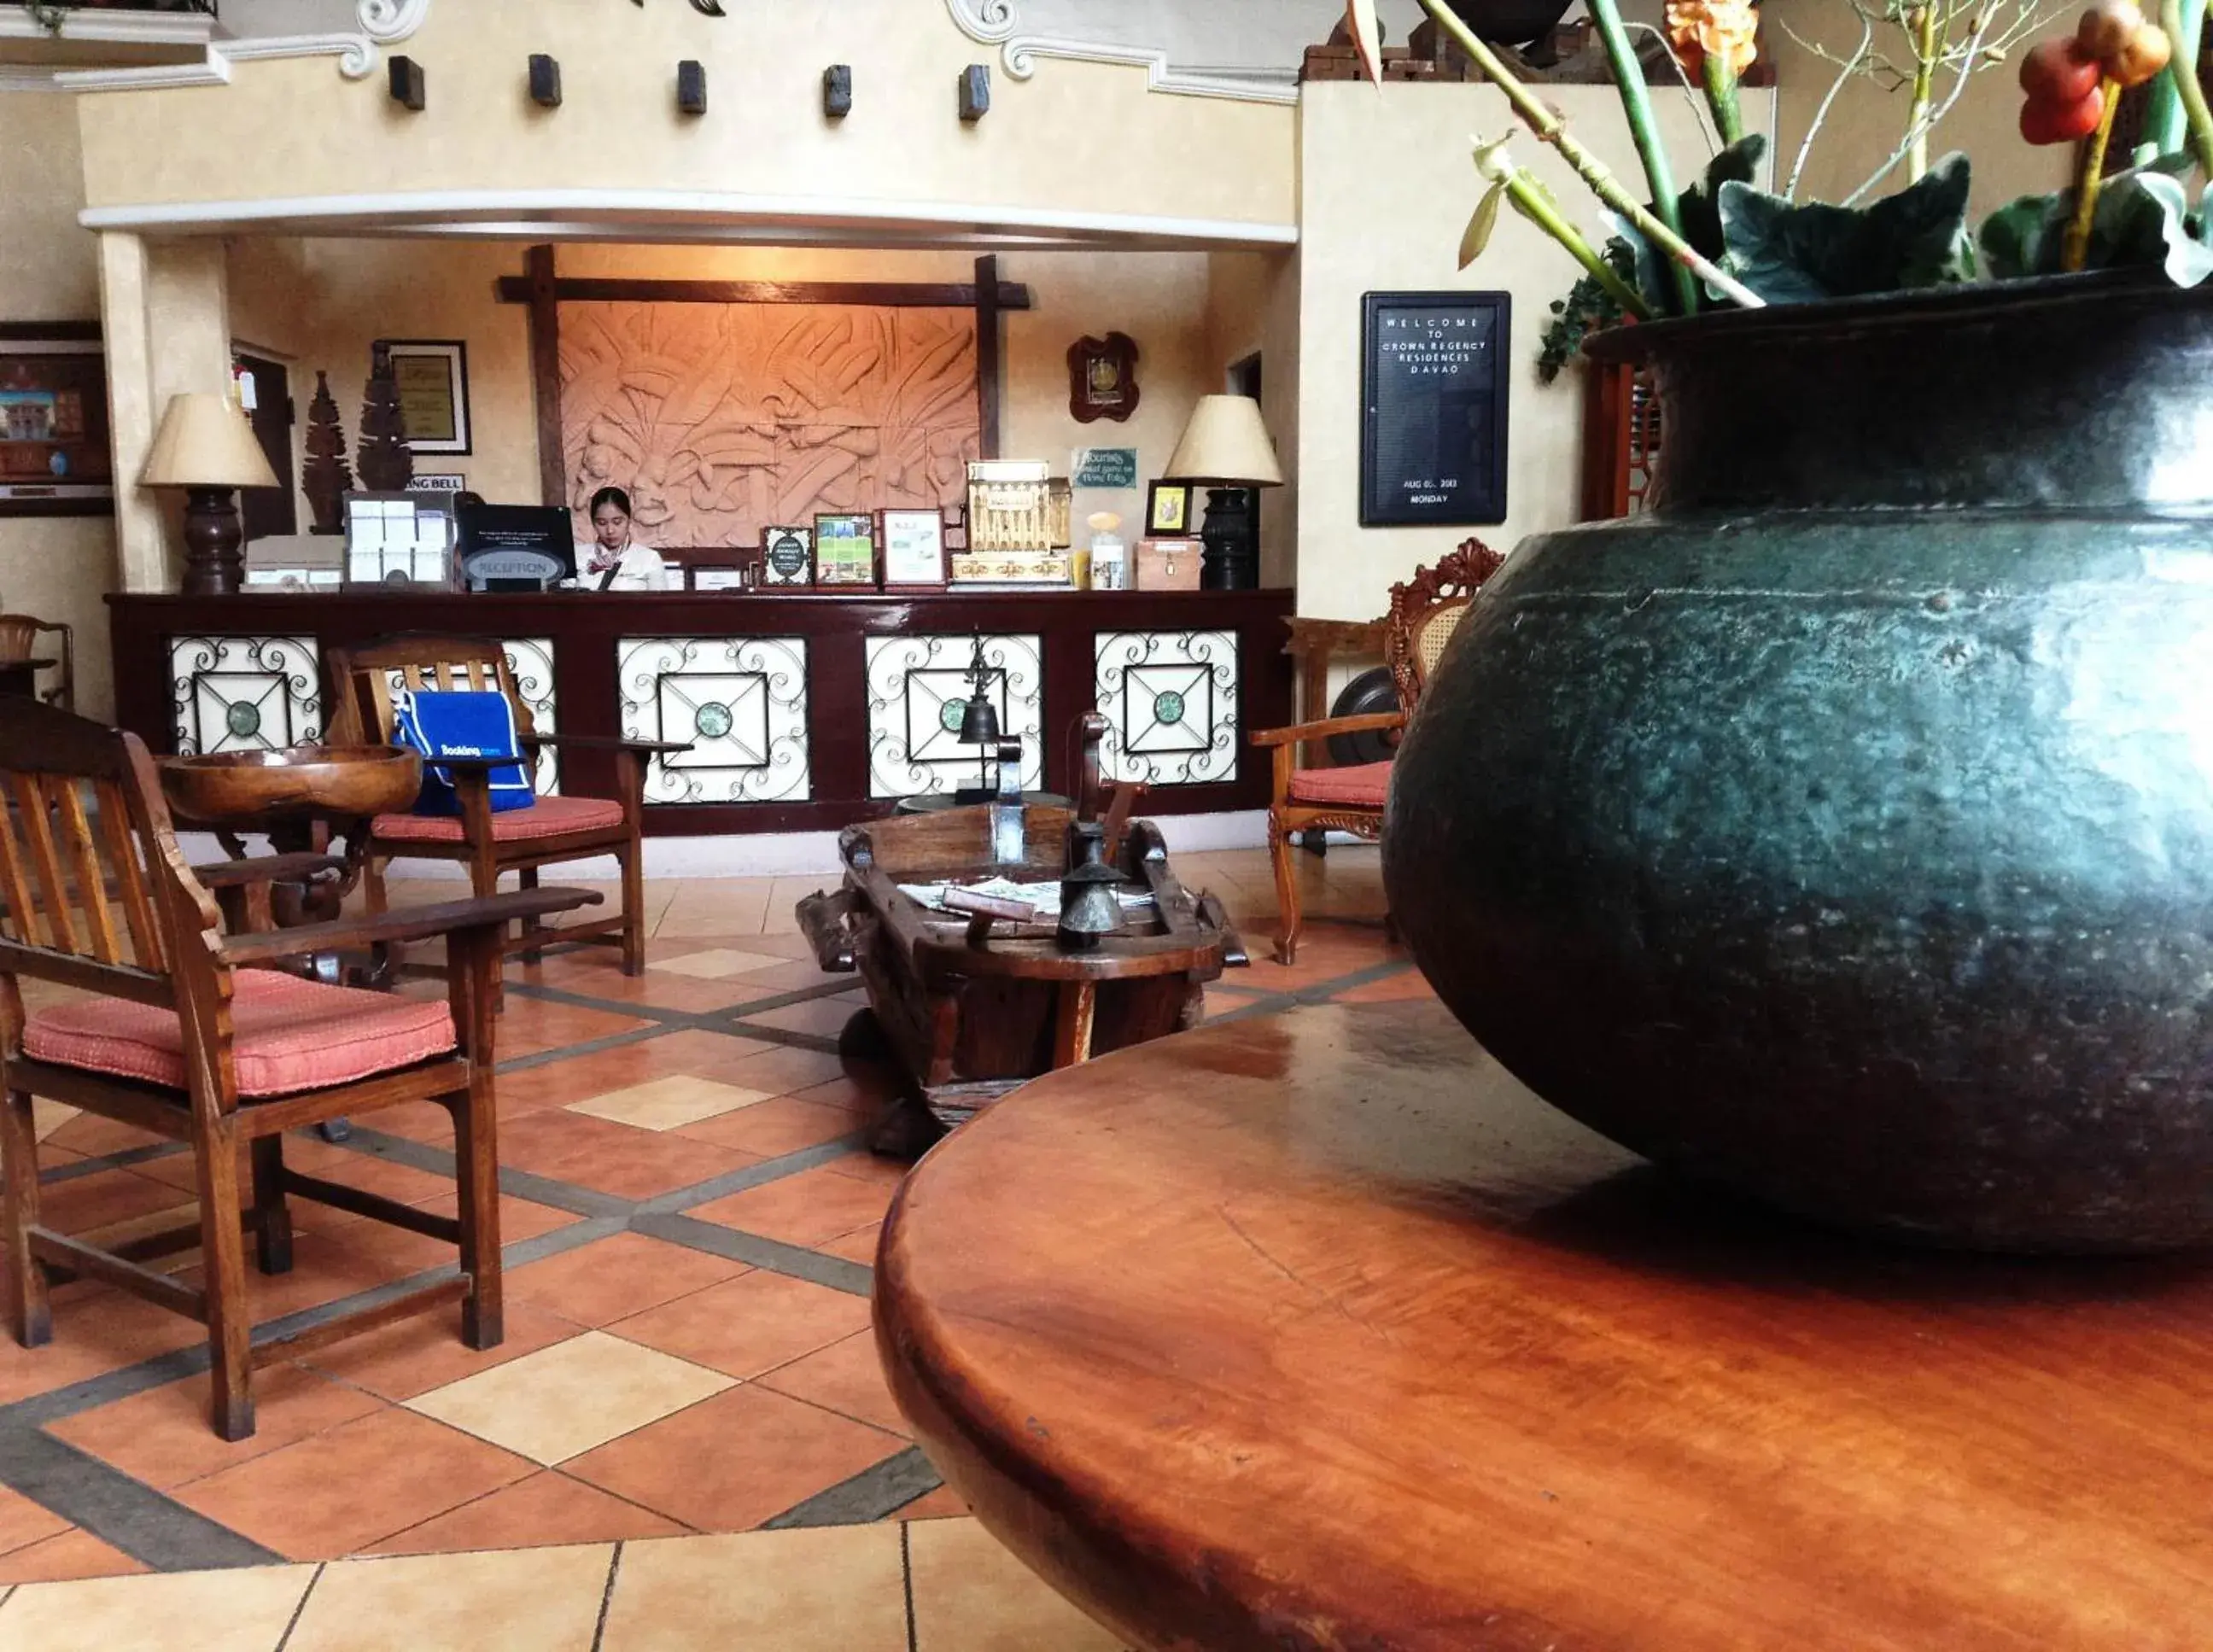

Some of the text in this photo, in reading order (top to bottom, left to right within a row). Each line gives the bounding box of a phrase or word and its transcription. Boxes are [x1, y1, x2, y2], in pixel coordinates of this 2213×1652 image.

[1387, 318, 1476, 327] WELCOME
[1382, 341, 1486, 351] CROWN REGENCY
[1399, 353, 1469, 362] RESIDENCES
[1410, 365, 1458, 374] DAVAO
[431, 478, 460, 489] BELL
[1404, 480, 1422, 488] AUG
[1410, 494, 1448, 504] MONDAY
[479, 561, 547, 574] RECEPTION
